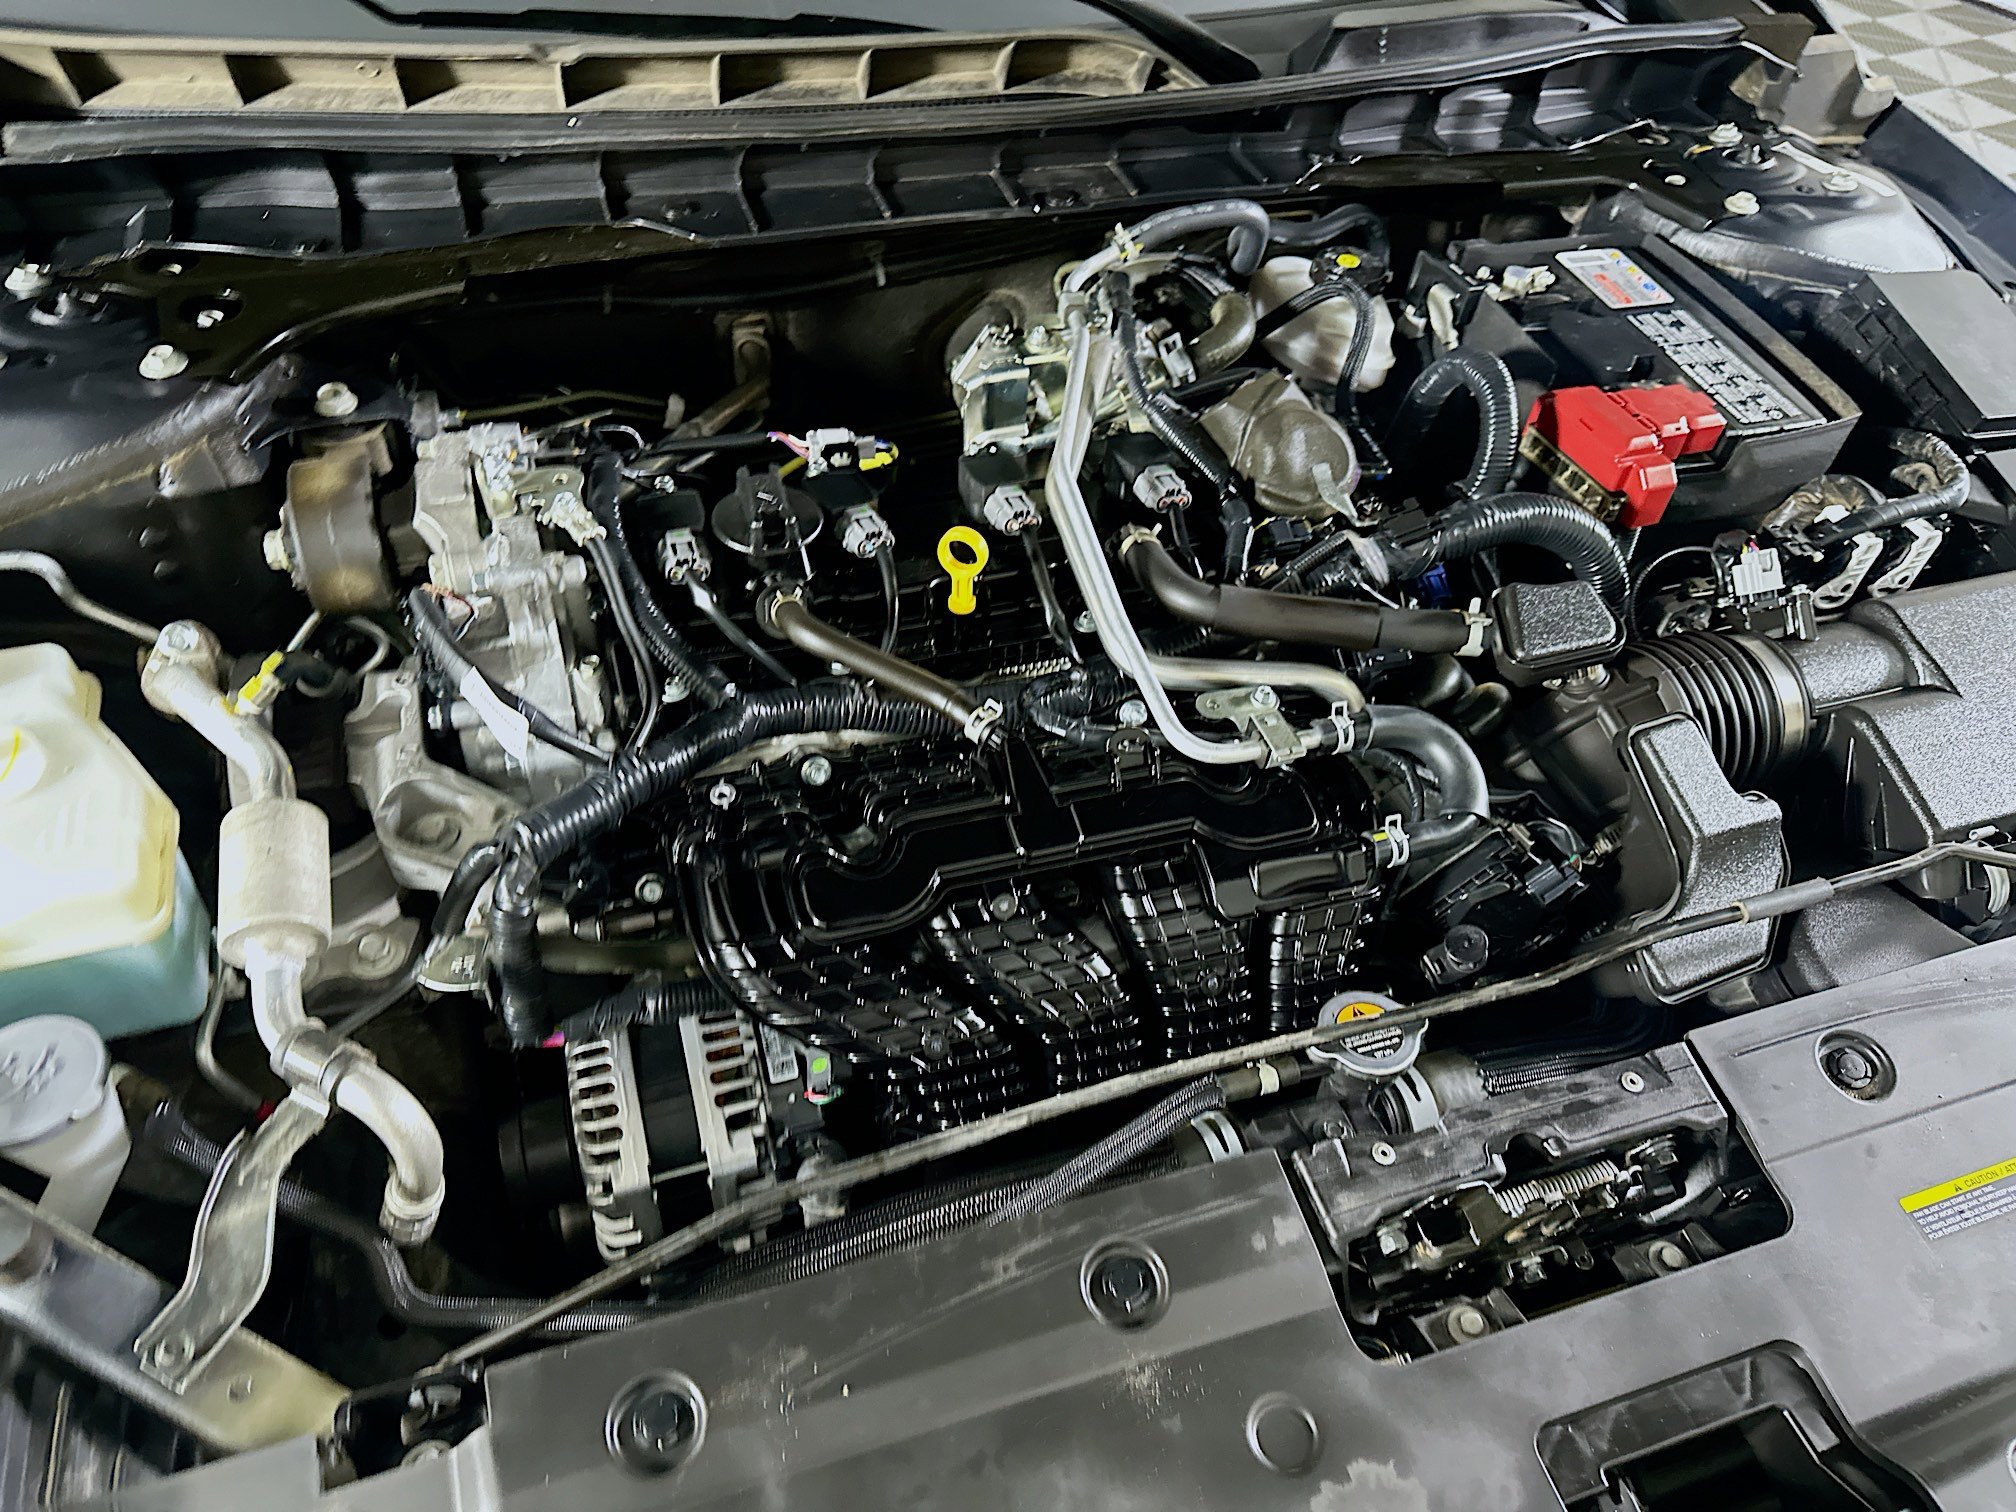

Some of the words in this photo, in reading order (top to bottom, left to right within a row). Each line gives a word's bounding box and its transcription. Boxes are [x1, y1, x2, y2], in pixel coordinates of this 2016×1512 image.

[1964, 1170, 1999, 1187] CAUTION
[1950, 1195, 1966, 1204] START
[1925, 1214, 1939, 1222] HELP
[1927, 1230, 1944, 1240] POUR
